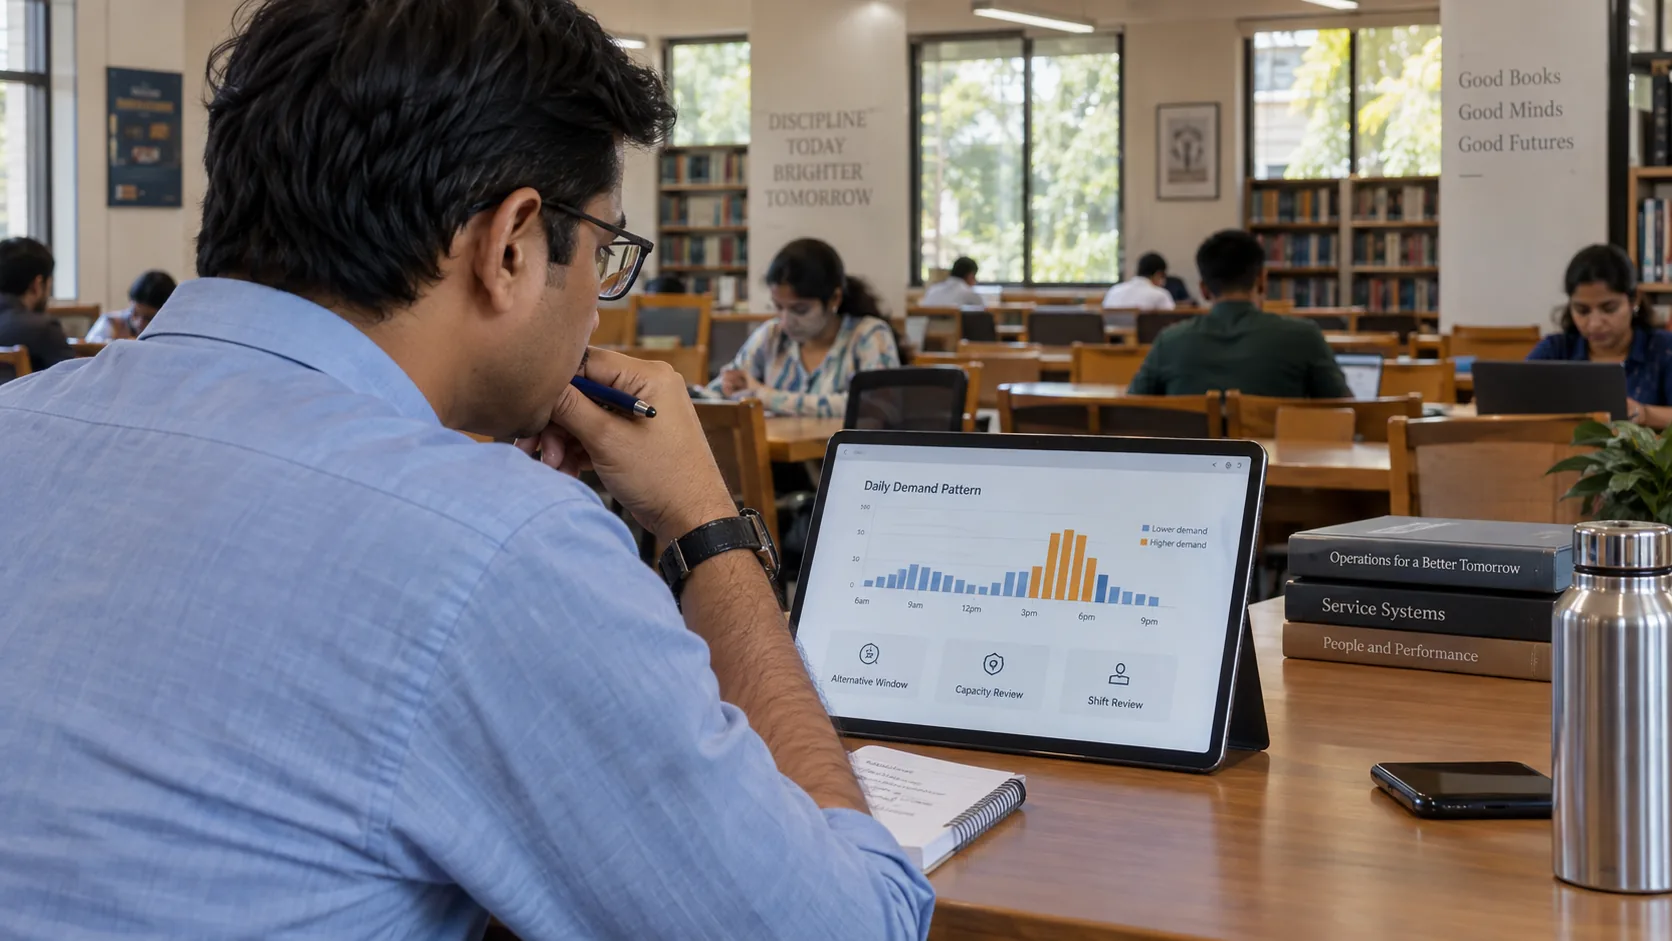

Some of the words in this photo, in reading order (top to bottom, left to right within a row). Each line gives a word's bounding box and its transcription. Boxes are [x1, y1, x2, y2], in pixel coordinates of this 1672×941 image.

[1458, 69, 1503, 89] Good
[1509, 66, 1561, 86] Books
[768, 109, 867, 131] DISCIPLINE
[1458, 101, 1503, 121] Good
[1509, 99, 1563, 119] Minds
[785, 137, 847, 156] TODAY
[1458, 133, 1503, 153] Good
[1509, 133, 1575, 152] Futures
[773, 162, 863, 182] BRIGHTER
[764, 187, 873, 208] TOMORROW
[864, 480, 891, 494] Daily
[893, 482, 939, 494] Demand
[941, 483, 982, 496] Pattern
[1152, 524, 1176, 533] Lower
[1176, 526, 1208, 535] demand
[1150, 538, 1175, 549] Higher
[1176, 540, 1207, 549] demand
[1329, 551, 1391, 567] Operations
[1394, 554, 1411, 567] for
[1412, 558, 1419, 568] a
[1422, 557, 1457, 570] Better
[1459, 559, 1521, 574] Tomorrow
[854, 597, 870, 605] 6am
[907, 601, 923, 609] 9am
[961, 604, 982, 614] 12pm
[1020, 608, 1038, 618] 3pm
[1078, 612, 1096, 621] 6pm
[1140, 616, 1159, 627] 9pm
[1322, 598, 1377, 616] Service
[1381, 602, 1446, 621] Systems
[1323, 636, 1365, 654] People
[1367, 641, 1392, 655] and
[1395, 643, 1479, 662] Performance
[831, 674, 873, 686] Alternative
[875, 678, 908, 689] Window
[955, 684, 991, 698] Capacity
[993, 688, 1024, 699] Review
[1087, 695, 1109, 706] Shift
[1111, 698, 1144, 709] Review
